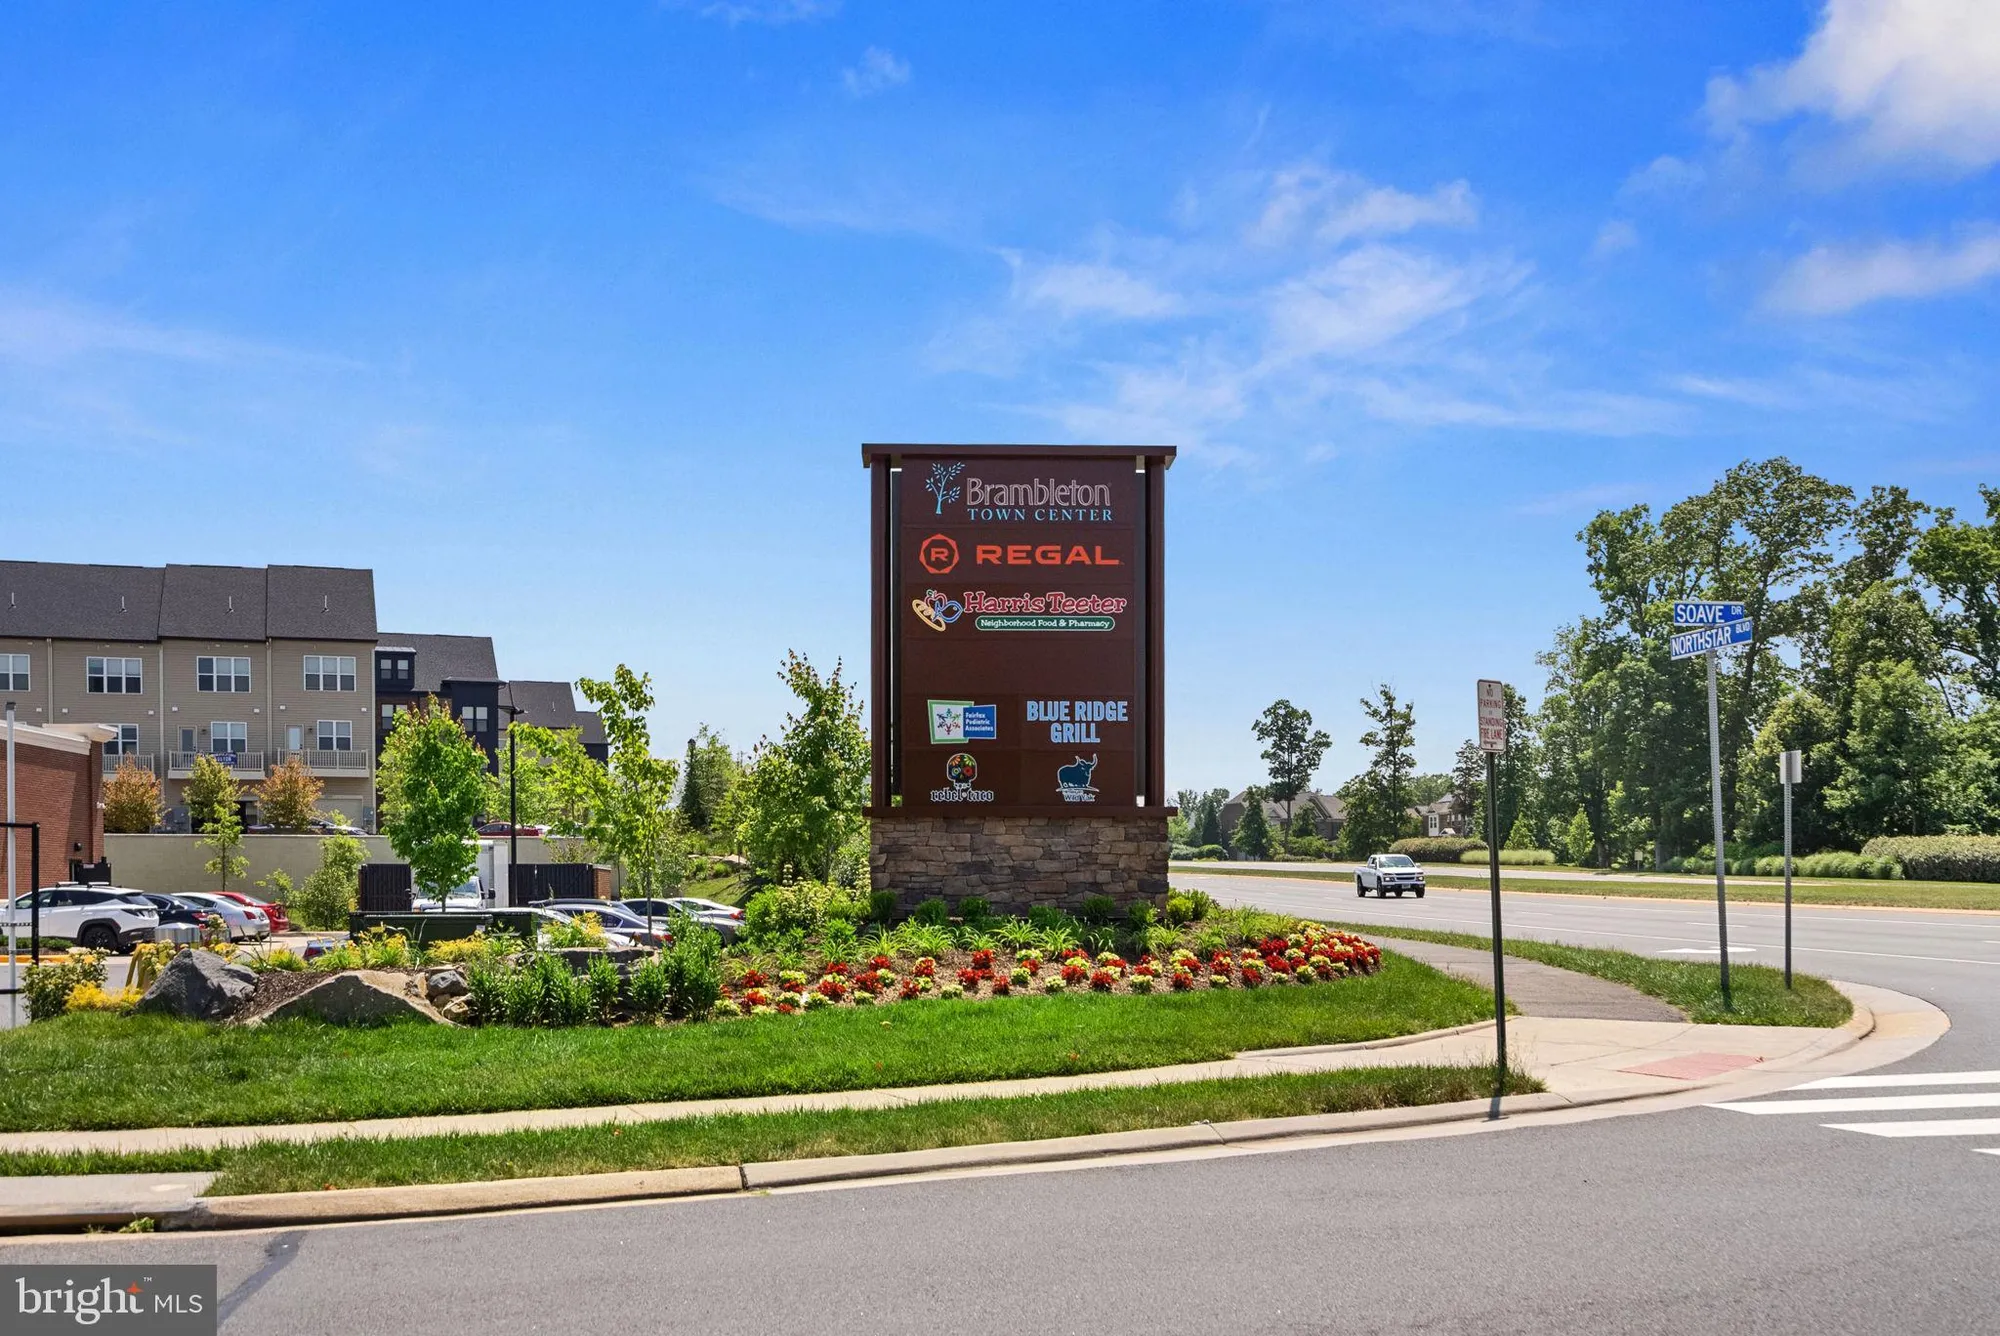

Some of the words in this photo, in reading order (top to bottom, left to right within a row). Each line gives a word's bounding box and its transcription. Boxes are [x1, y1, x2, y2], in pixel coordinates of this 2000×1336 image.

[966, 478, 1111, 506] Brambleton
[967, 508, 1025, 521] TOWN
[1034, 508, 1112, 521] CENTER
[976, 545, 1120, 565] REGAL
[963, 591, 1045, 613] Harris
[1046, 591, 1128, 614] Teeter
[980, 619, 1037, 630] Neighborhood
[1038, 619, 1057, 628] Food
[1059, 619, 1067, 627] &
[1068, 619, 1110, 629] Pharmacy
[1676, 605, 1725, 623] SOAVE
[1731, 606, 1742, 615] DR
[1671, 626, 1732, 656] NORTHSTAR
[1735, 621, 1750, 634] BLVD
[1027, 700, 1070, 722] BLUE
[1075, 700, 1128, 722] RIDGE
[1050, 722, 1101, 743] GRILL
